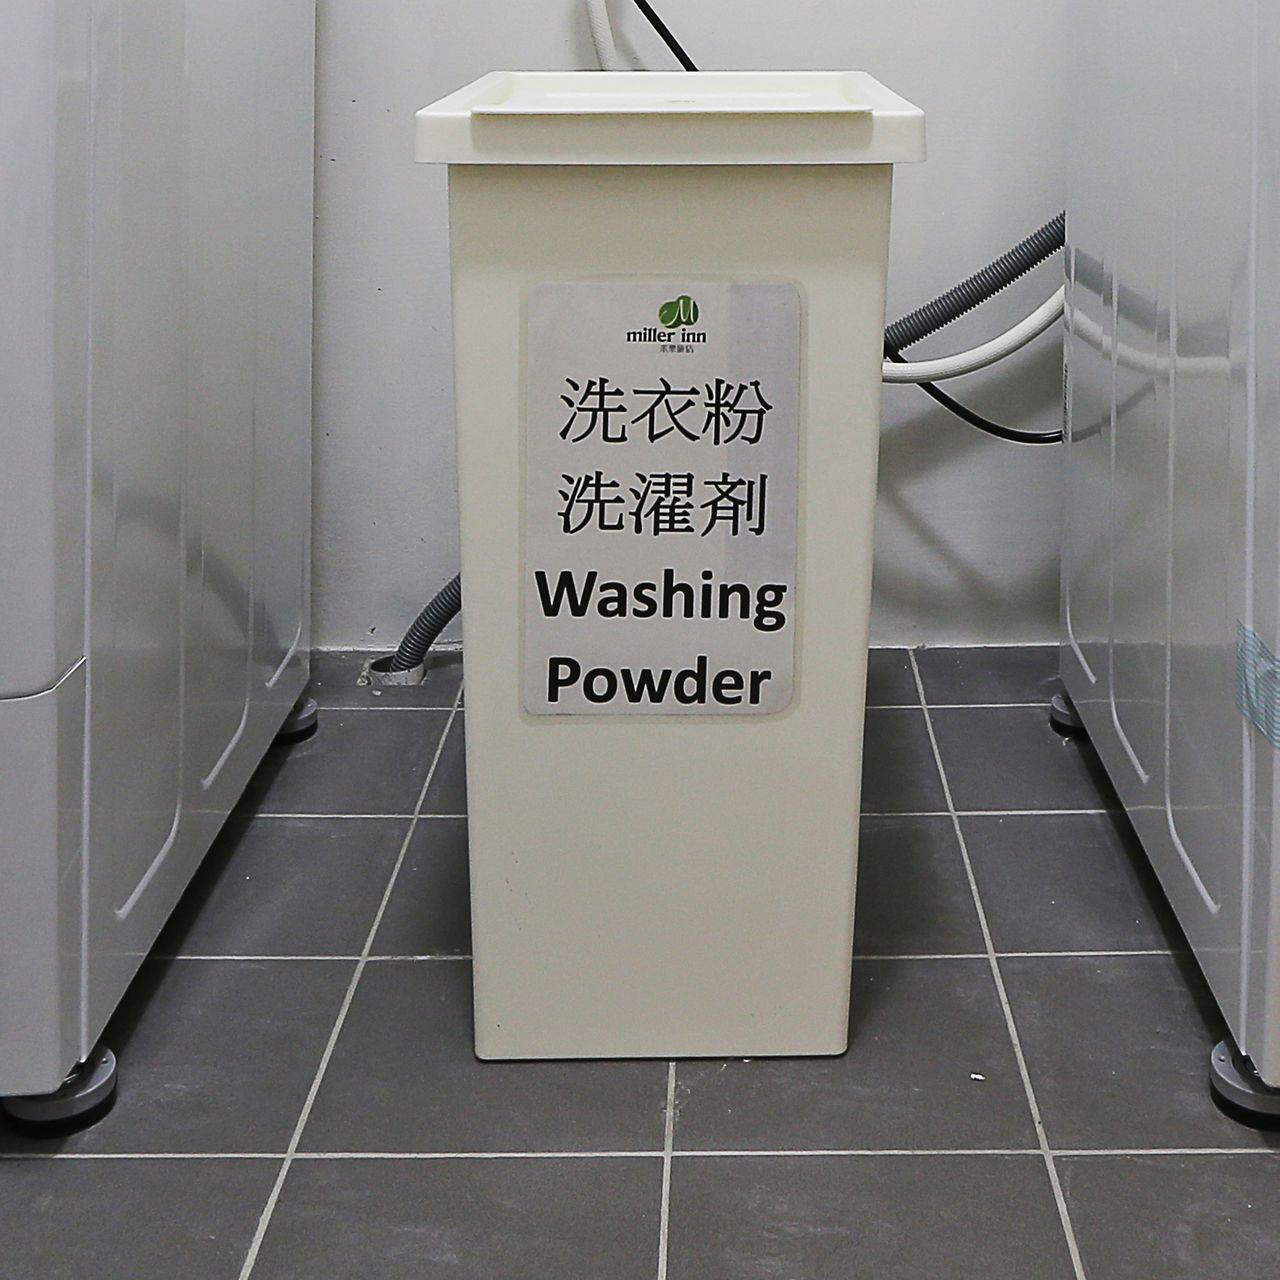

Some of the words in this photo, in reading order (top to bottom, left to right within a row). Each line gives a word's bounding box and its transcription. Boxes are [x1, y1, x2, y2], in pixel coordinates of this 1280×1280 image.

[626, 328, 676, 344] miller
[681, 328, 707, 344] inn
[559, 377, 773, 446] 洗衣粉
[557, 470, 769, 537] 洗濯剤
[534, 569, 788, 632] Washing
[547, 655, 772, 705] Powder
